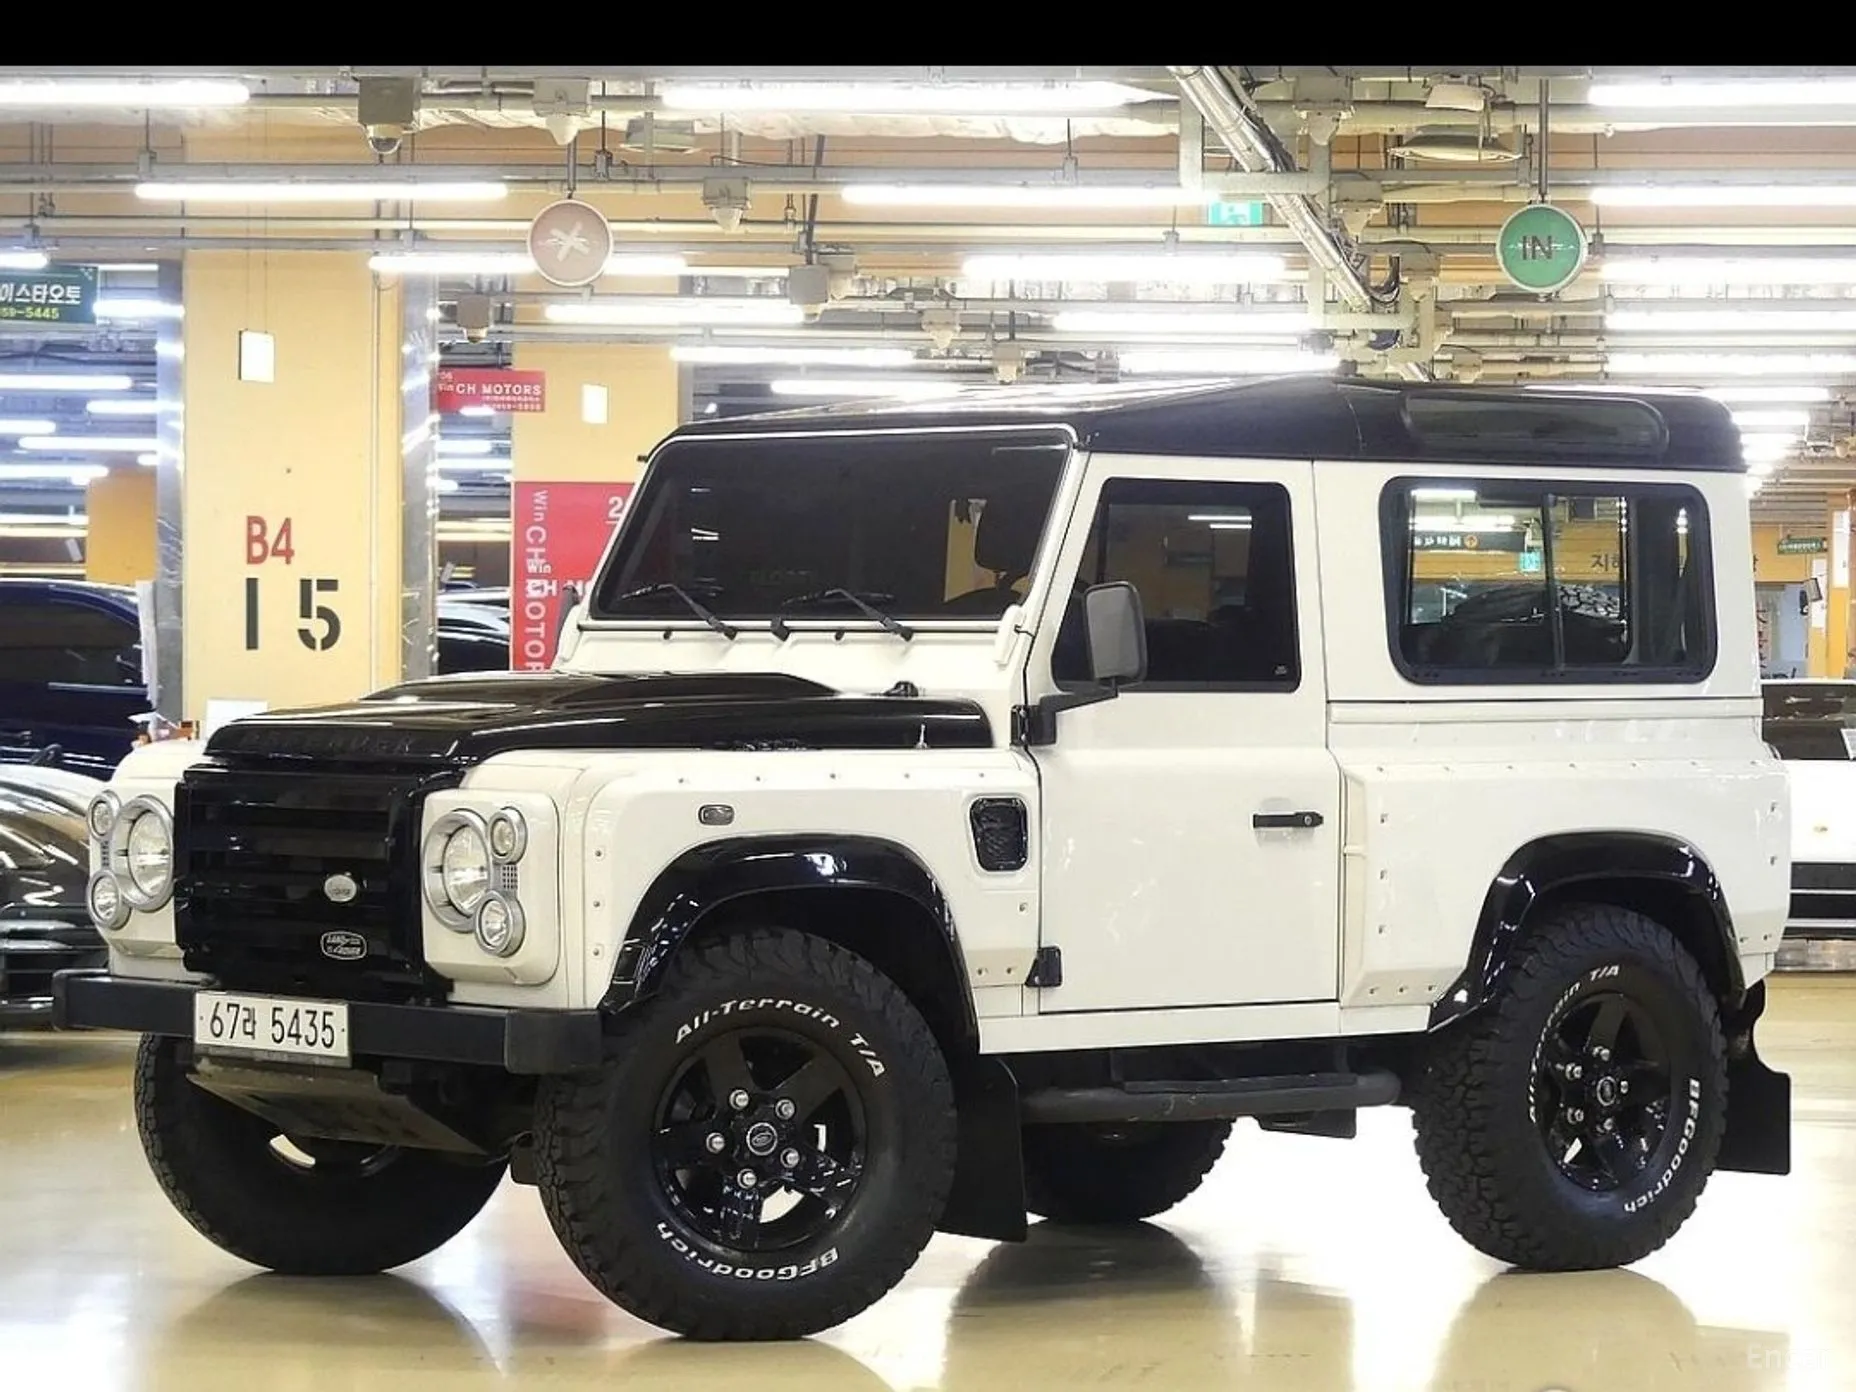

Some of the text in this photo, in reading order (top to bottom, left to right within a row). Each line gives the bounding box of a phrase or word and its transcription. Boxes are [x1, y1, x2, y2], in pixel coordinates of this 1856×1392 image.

[1523, 235, 1552, 260] IN
[481, 384, 542, 395] MOTORS
[246, 515, 295, 565] B4
[210, 1002, 335, 1049] 67라 5435
[675, 998, 886, 1077] All-Terrain T/A
[1624, 1078, 1700, 1213] BFGoodrich
[657, 1222, 839, 1280] BFGoodrich
